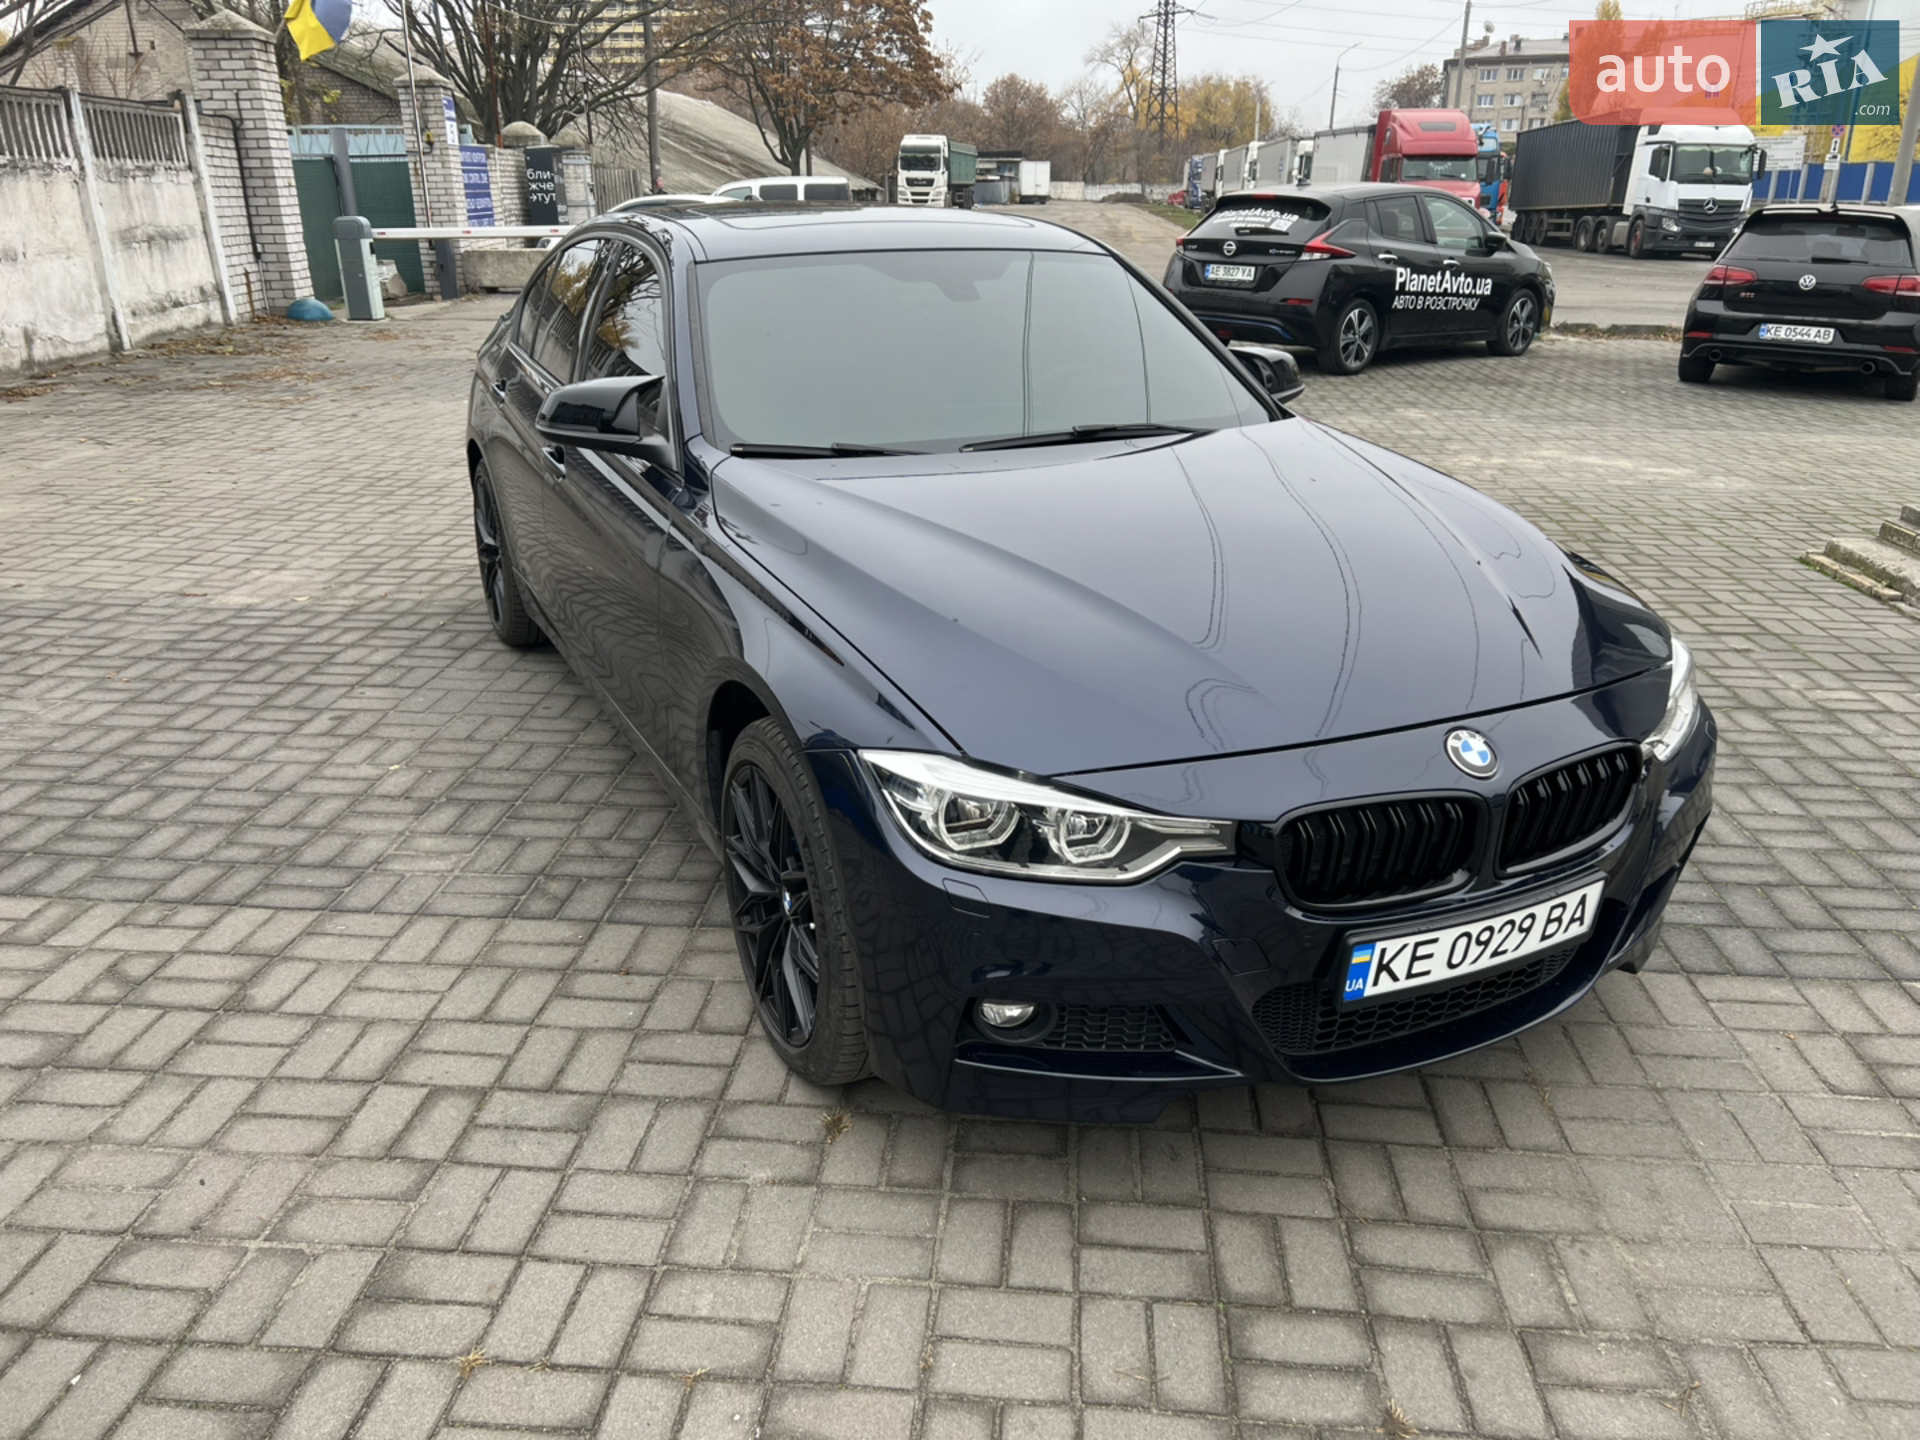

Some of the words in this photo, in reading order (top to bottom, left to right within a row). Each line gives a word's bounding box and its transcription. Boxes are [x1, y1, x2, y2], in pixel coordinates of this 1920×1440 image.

[528, 181, 555, 191] жче
[1211, 265, 1221, 276] AE
[1222, 266, 1241, 277] 3827
[1241, 267, 1253, 278] YA
[1395, 267, 1493, 296] PlanetAvto.ua
[1391, 295, 1417, 309] АВТО
[1424, 296, 1480, 311] РОЗСТРОЧКУ
[1765, 326, 1783, 337] KE
[1784, 327, 1812, 338] 0544
[1814, 329, 1832, 341] AB
[1372, 937, 1440, 987] KE
[1446, 912, 1537, 970] 0929
[1539, 892, 1588, 943] BA
[1345, 977, 1364, 992] UA
